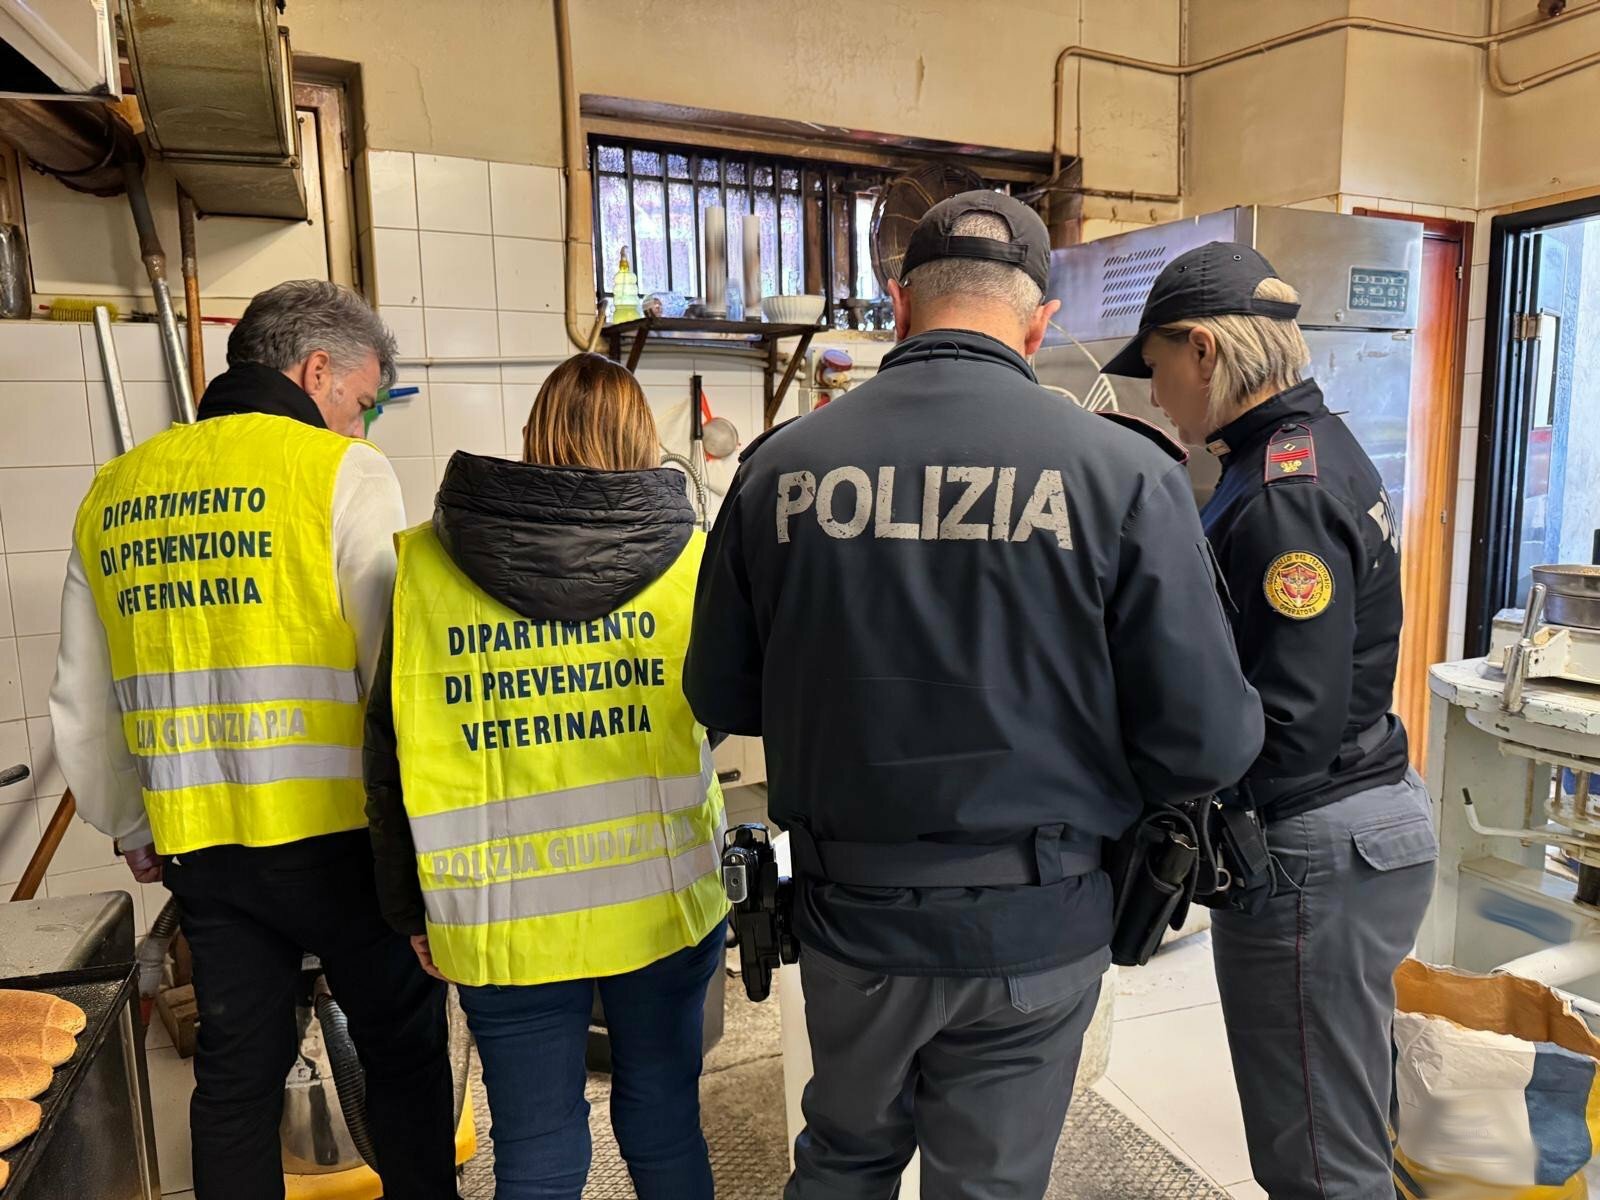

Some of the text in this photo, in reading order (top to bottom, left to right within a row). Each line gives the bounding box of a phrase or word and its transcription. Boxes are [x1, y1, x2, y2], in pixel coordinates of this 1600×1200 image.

[103, 487, 266, 532] DIPARTIMENTO
[776, 466, 1074, 551] POLIZIA
[100, 530, 273, 577] DI PREVENZIONE
[117, 577, 263, 618] VETERINARIA
[448, 611, 656, 656] DIPARTIMENTO
[445, 658, 665, 705] DI PREVENZIONE
[162, 708, 308, 748] GIUDIZIARIA
[462, 704, 652, 752] VETERINARIA
[432, 841, 541, 884] POLIZIA
